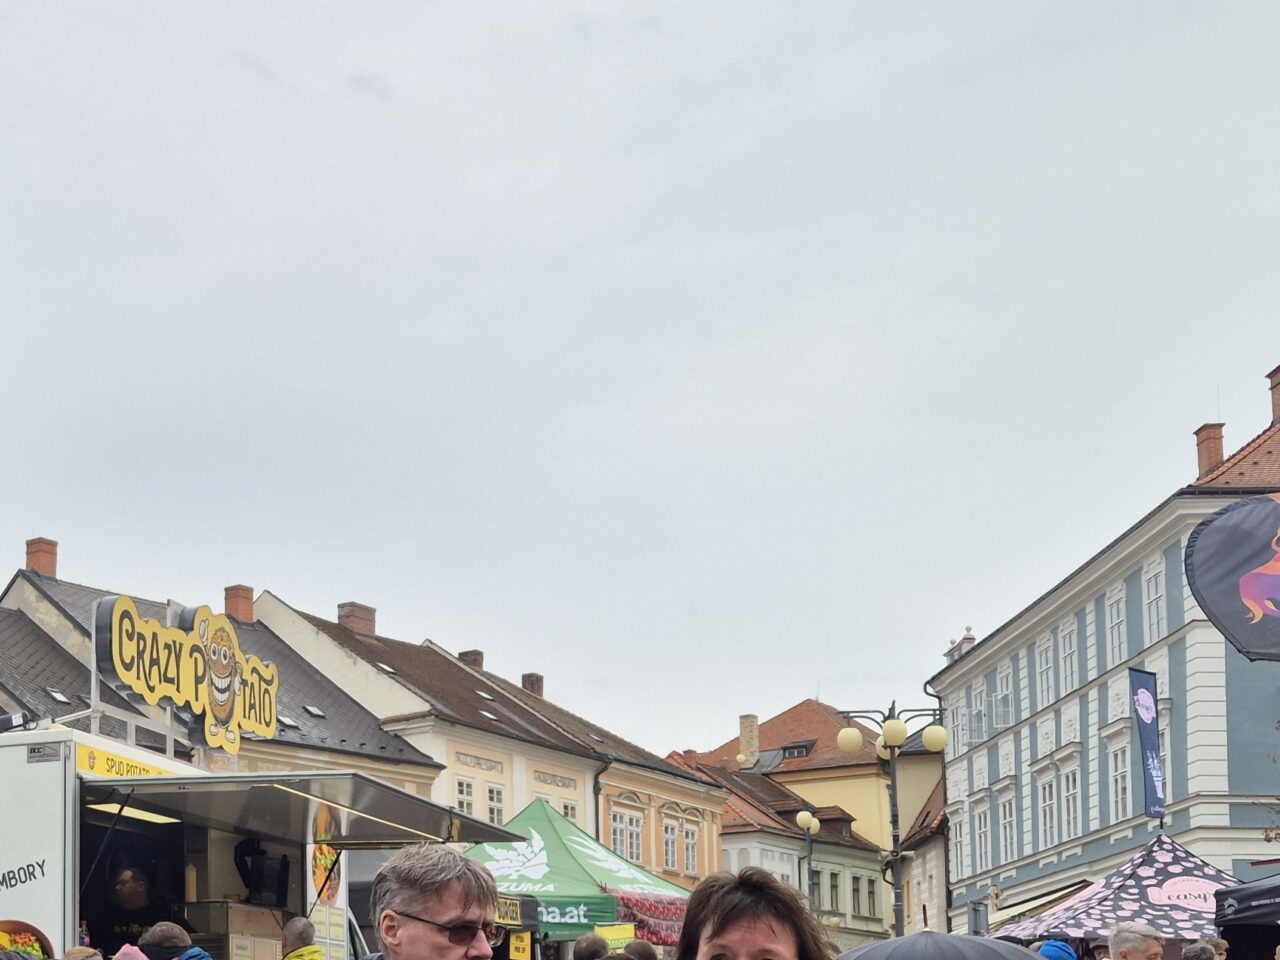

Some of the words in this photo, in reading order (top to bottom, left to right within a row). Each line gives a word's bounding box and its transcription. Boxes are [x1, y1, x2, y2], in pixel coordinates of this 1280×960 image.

[118, 609, 184, 694] CRAZY
[105, 757, 125, 777] SPUD
[497, 882, 556, 892] ZUMA
